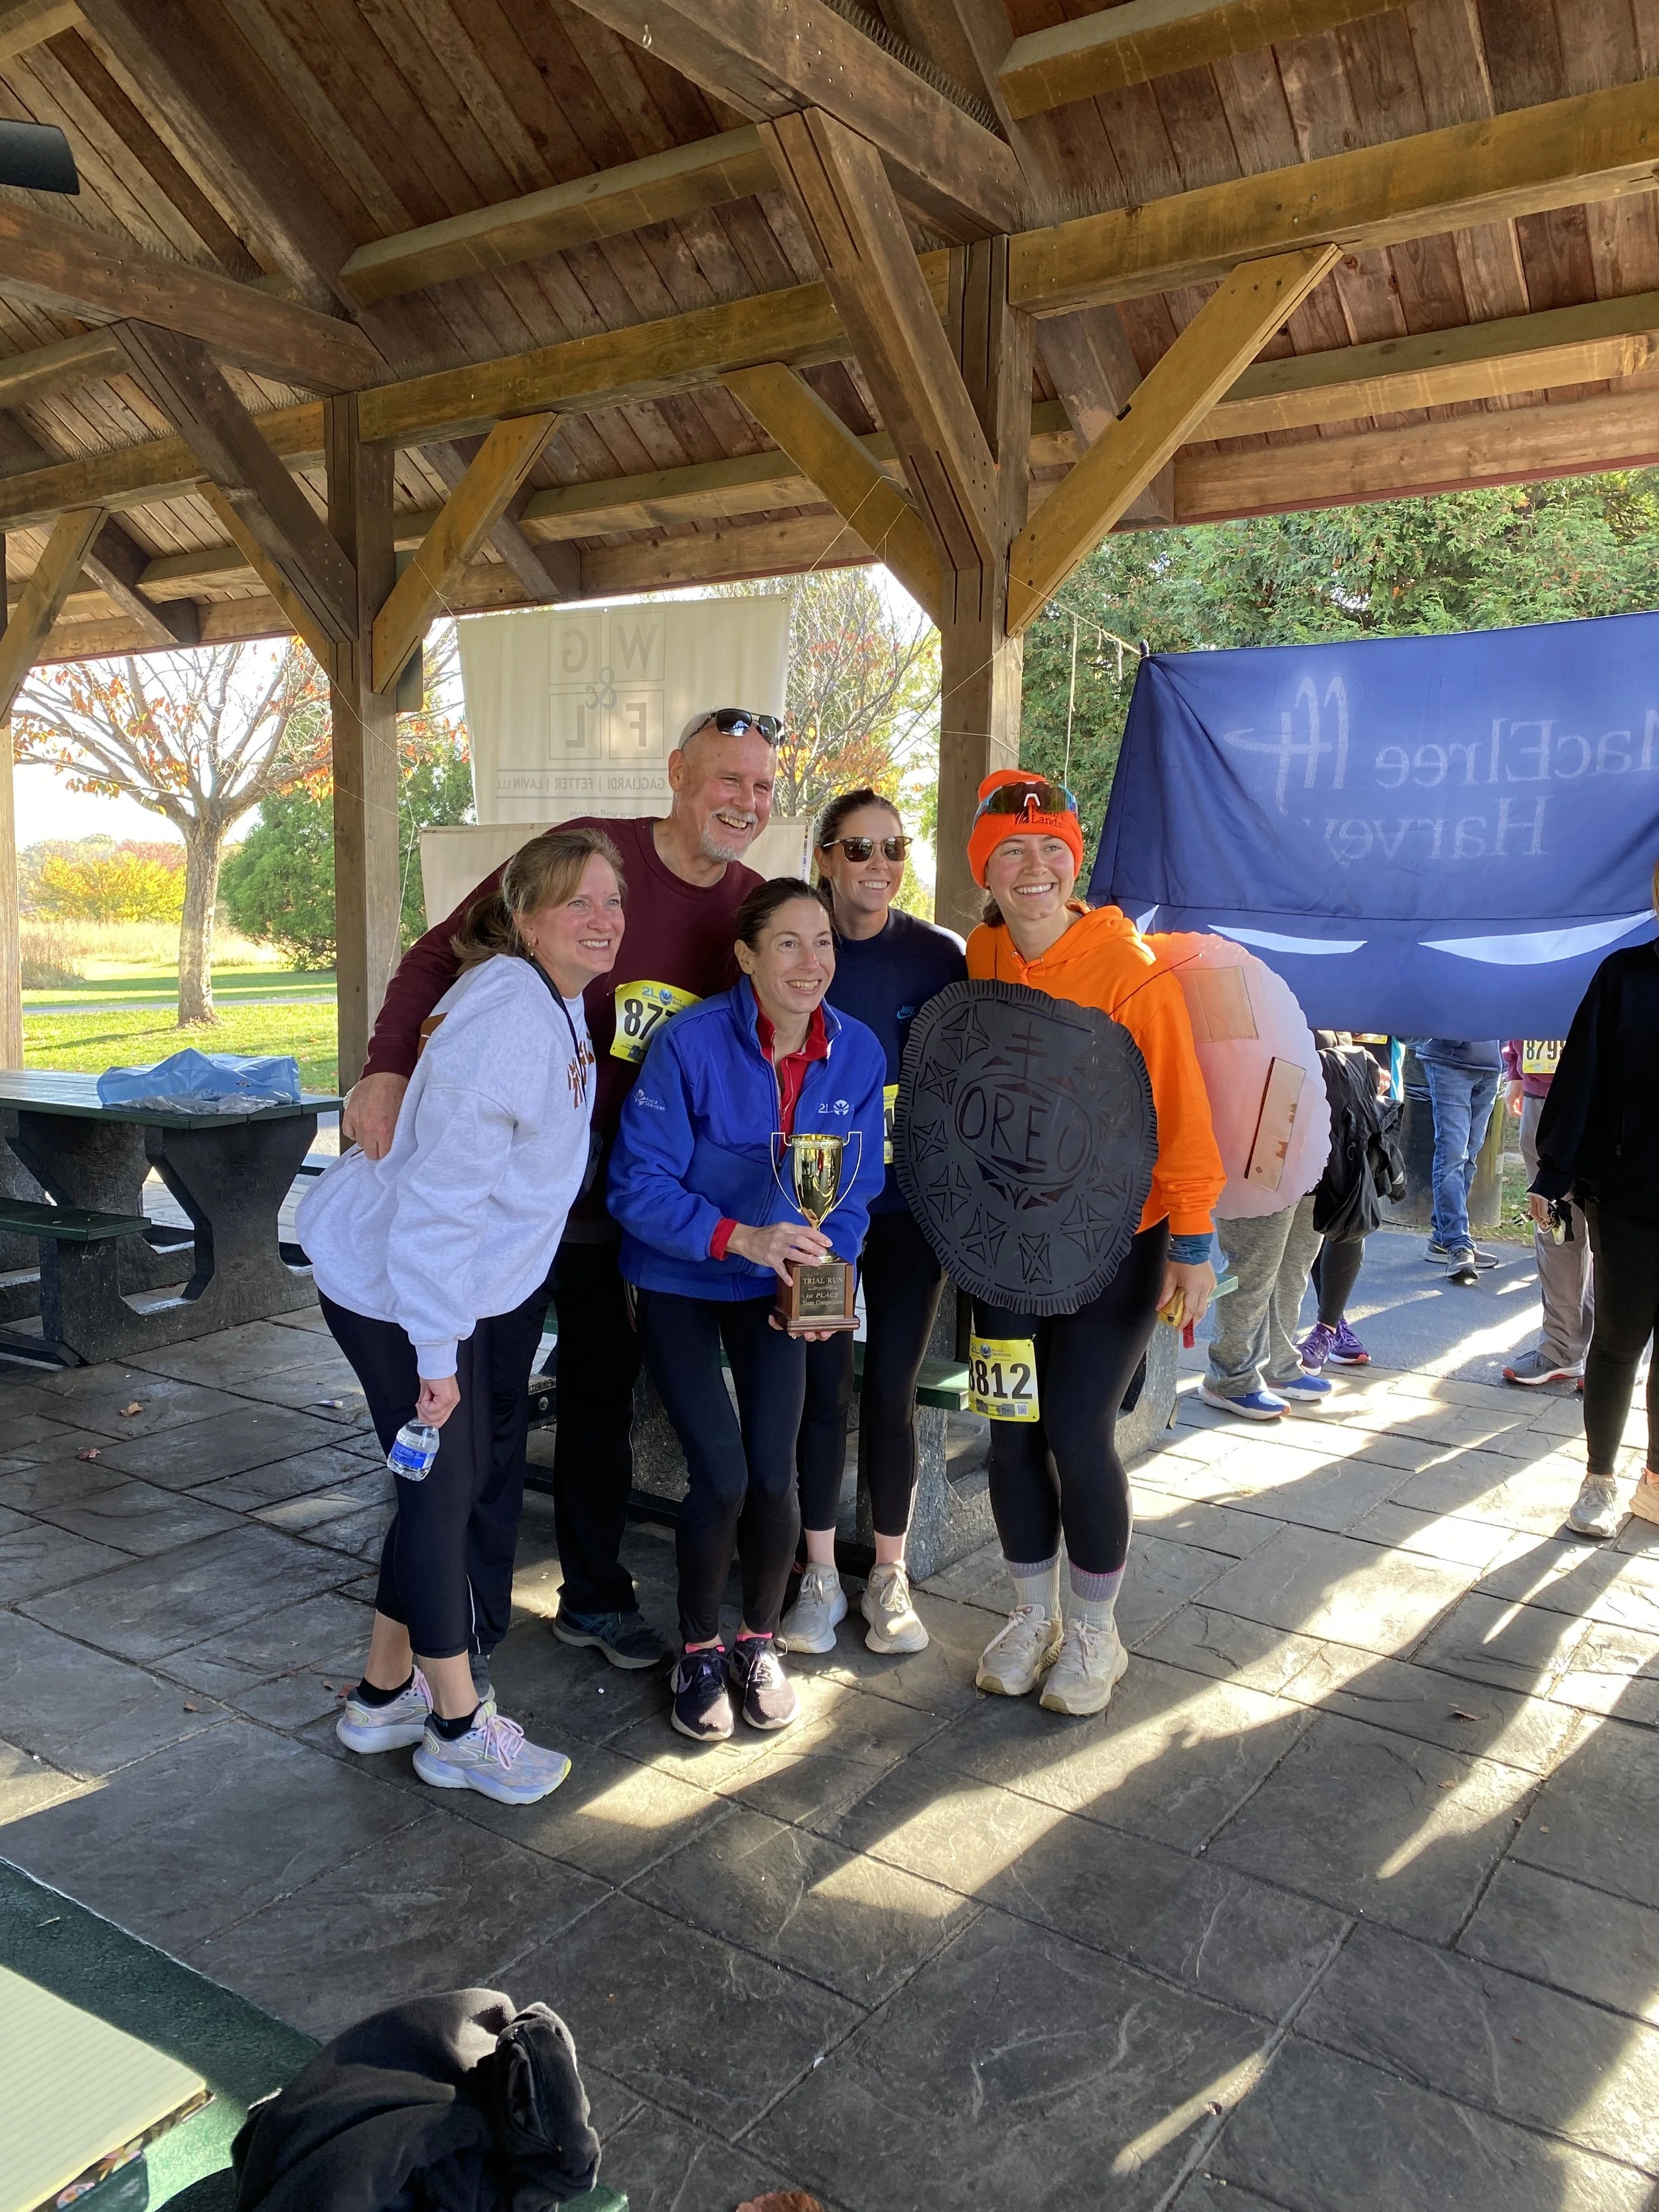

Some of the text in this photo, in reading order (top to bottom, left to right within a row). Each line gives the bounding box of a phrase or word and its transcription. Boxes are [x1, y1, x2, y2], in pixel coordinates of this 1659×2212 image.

[624, 998, 677, 1041] 87
[901, 1005, 916, 1015] NIKE
[957, 1085, 1088, 1173] OREO
